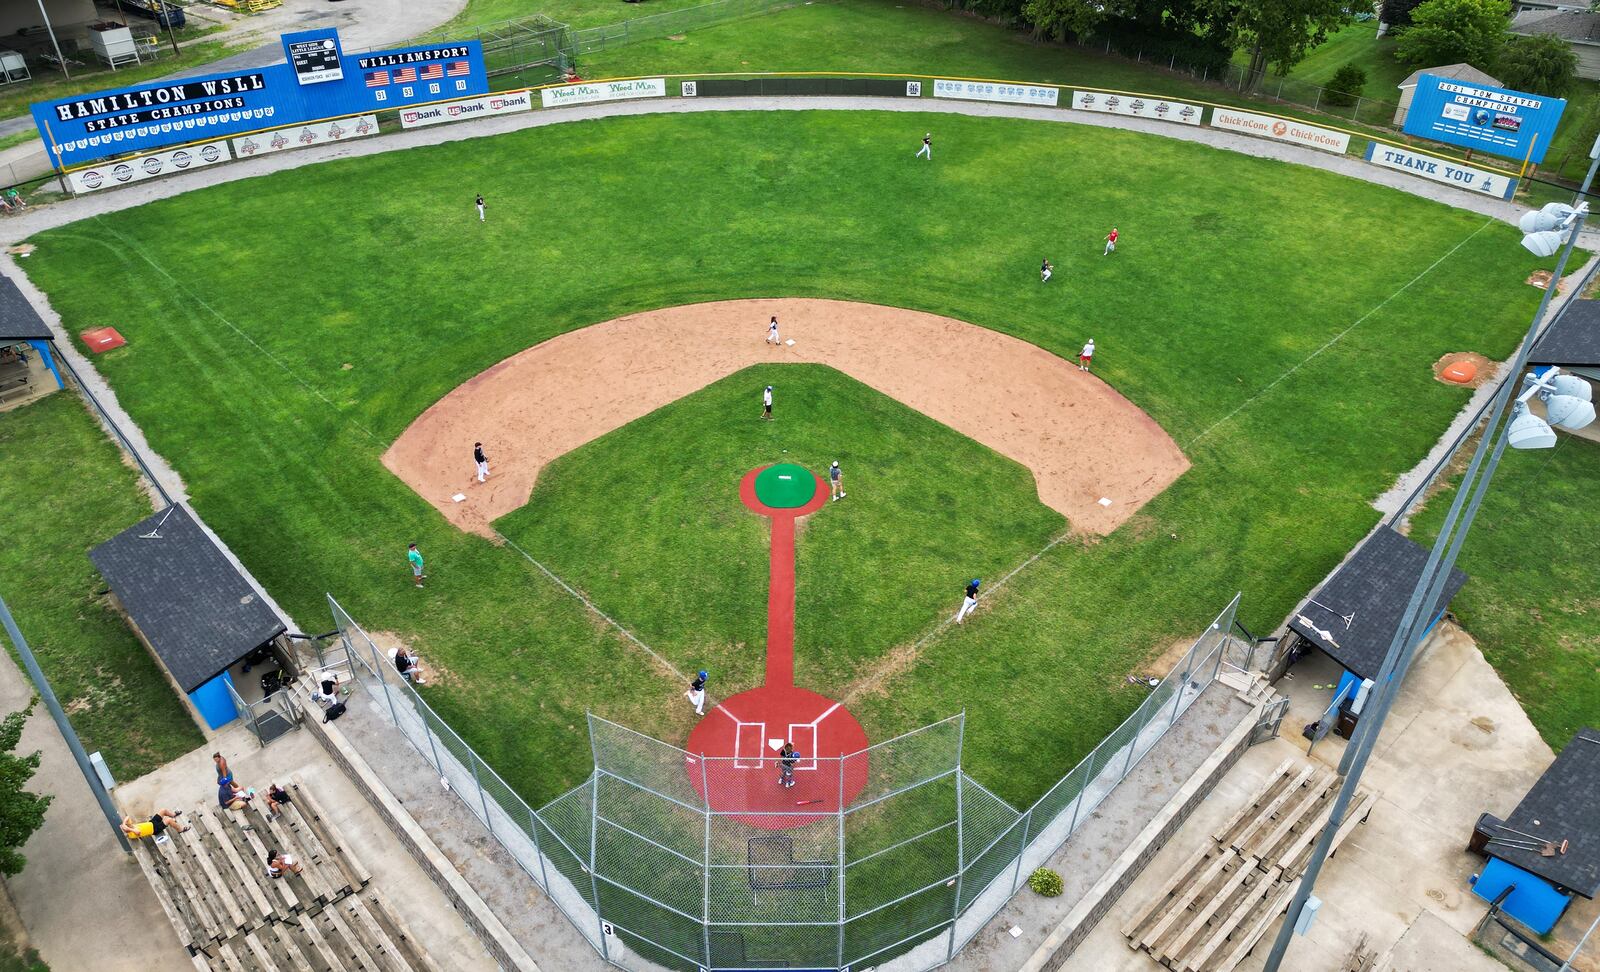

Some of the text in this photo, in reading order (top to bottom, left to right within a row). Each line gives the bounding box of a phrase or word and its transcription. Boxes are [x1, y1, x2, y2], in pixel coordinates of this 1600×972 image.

[359, 47, 468, 68] WILLIAMSPORT
[551, 89, 574, 98] Weed
[578, 86, 599, 95] Man
[636, 82, 656, 90] Man
[1439, 82, 1541, 108] 2021 TOM SEAVER
[56, 75, 264, 121] HAMILTON WSLL
[1456, 96, 1515, 112] CHAMPIONS
[87, 97, 243, 131] STATE CHAMPIONS
[1219, 114, 1269, 130] Chick'nCone
[1290, 128, 1341, 147] Chick'nCone
[1384, 151, 1475, 184] THANK YOU
[605, 925, 611, 935] 3
